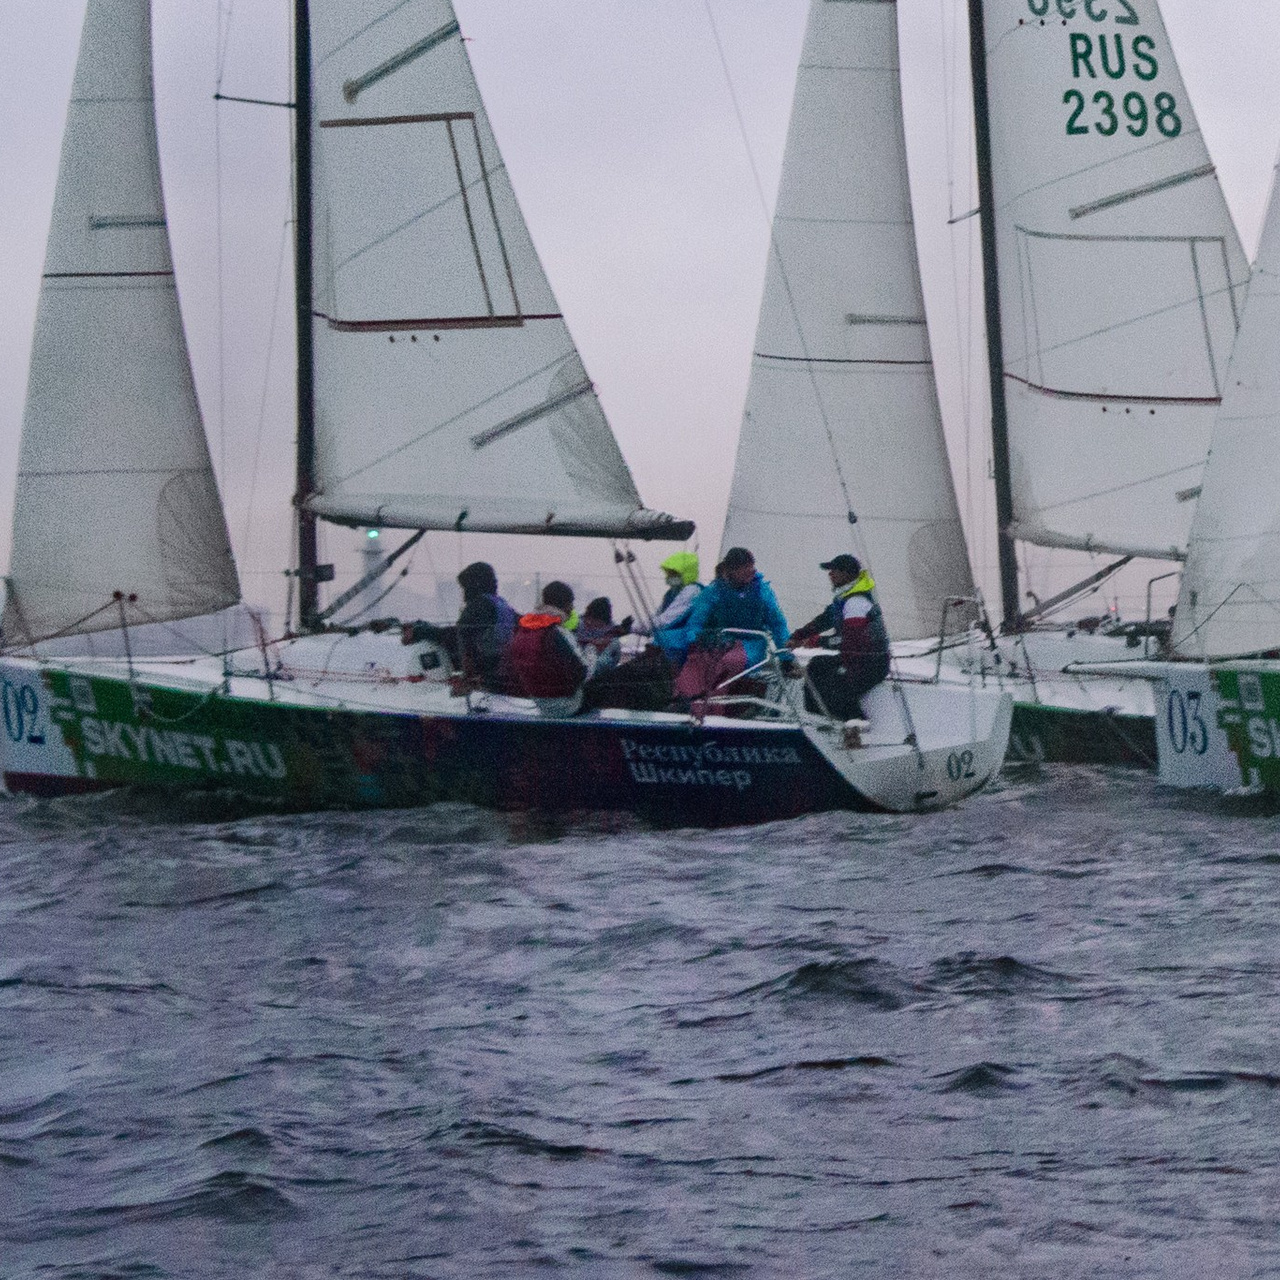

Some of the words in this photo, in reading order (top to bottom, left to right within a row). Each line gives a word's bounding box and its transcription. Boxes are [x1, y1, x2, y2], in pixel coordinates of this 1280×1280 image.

[1069, 32, 1159, 81] RUS
[1063, 89, 1182, 138] 2398
[3, 679, 46, 745] 02
[1167, 689, 1208, 756] 03
[80, 716, 289, 779] SKYNET.RU
[620, 738, 801, 767] Республика
[946, 749, 976, 781] 02
[628, 762, 752, 791] Шкипер
